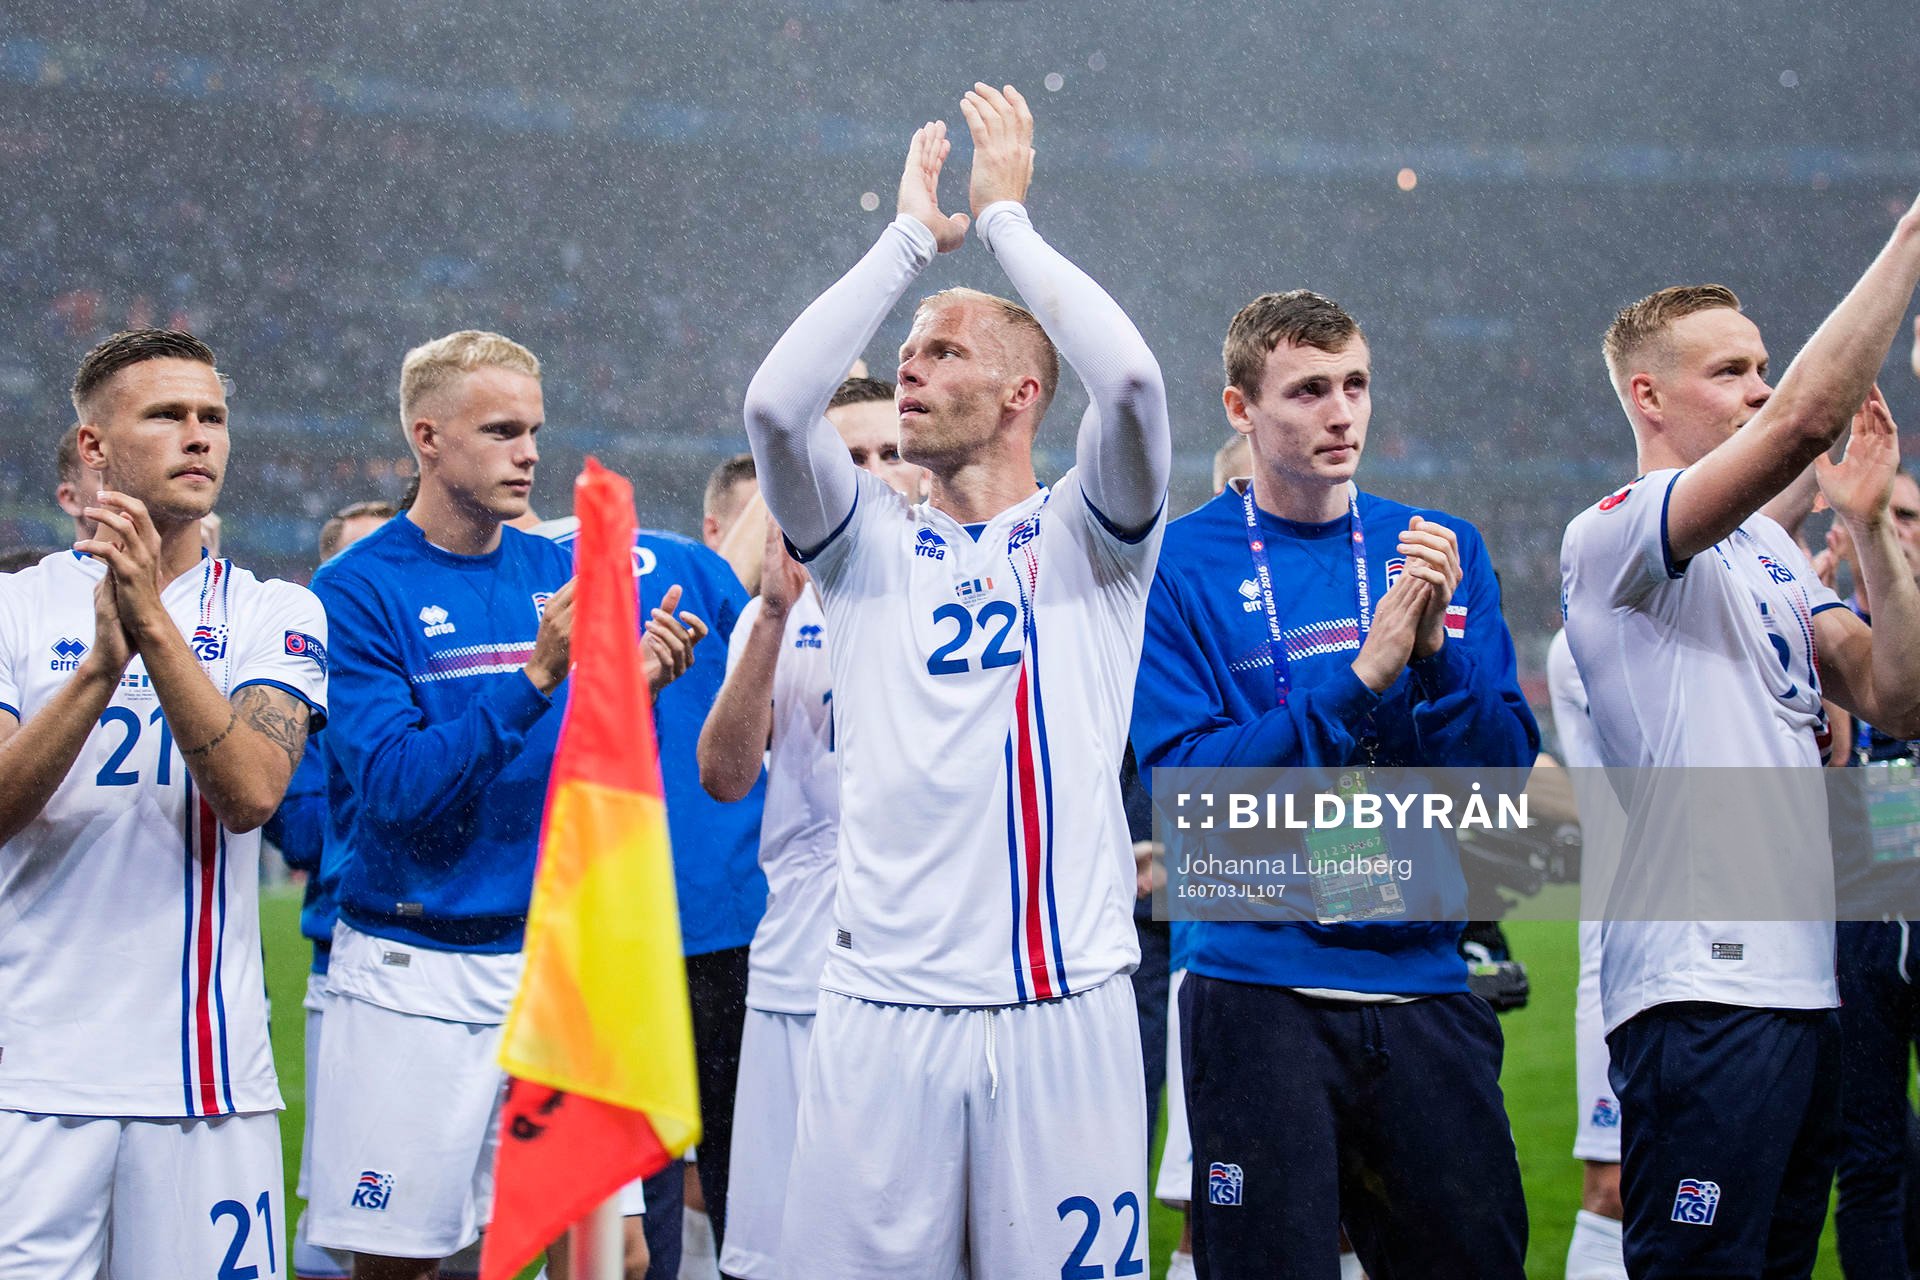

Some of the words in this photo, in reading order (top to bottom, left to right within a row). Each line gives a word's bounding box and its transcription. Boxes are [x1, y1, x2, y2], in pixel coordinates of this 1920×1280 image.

[1258, 565, 1272, 589] 2016
[1356, 557, 1367, 581] 2016
[1263, 590, 1277, 616] EURO
[1358, 581, 1369, 607] EURO
[1269, 616, 1282, 642] UEFA
[1360, 607, 1371, 633] UEFA
[926, 600, 1022, 676] 22
[51, 659, 80, 671] erre
[96, 706, 174, 787] 21
[209, 1190, 276, 1280] 21
[1056, 1191, 1144, 1280] 22
